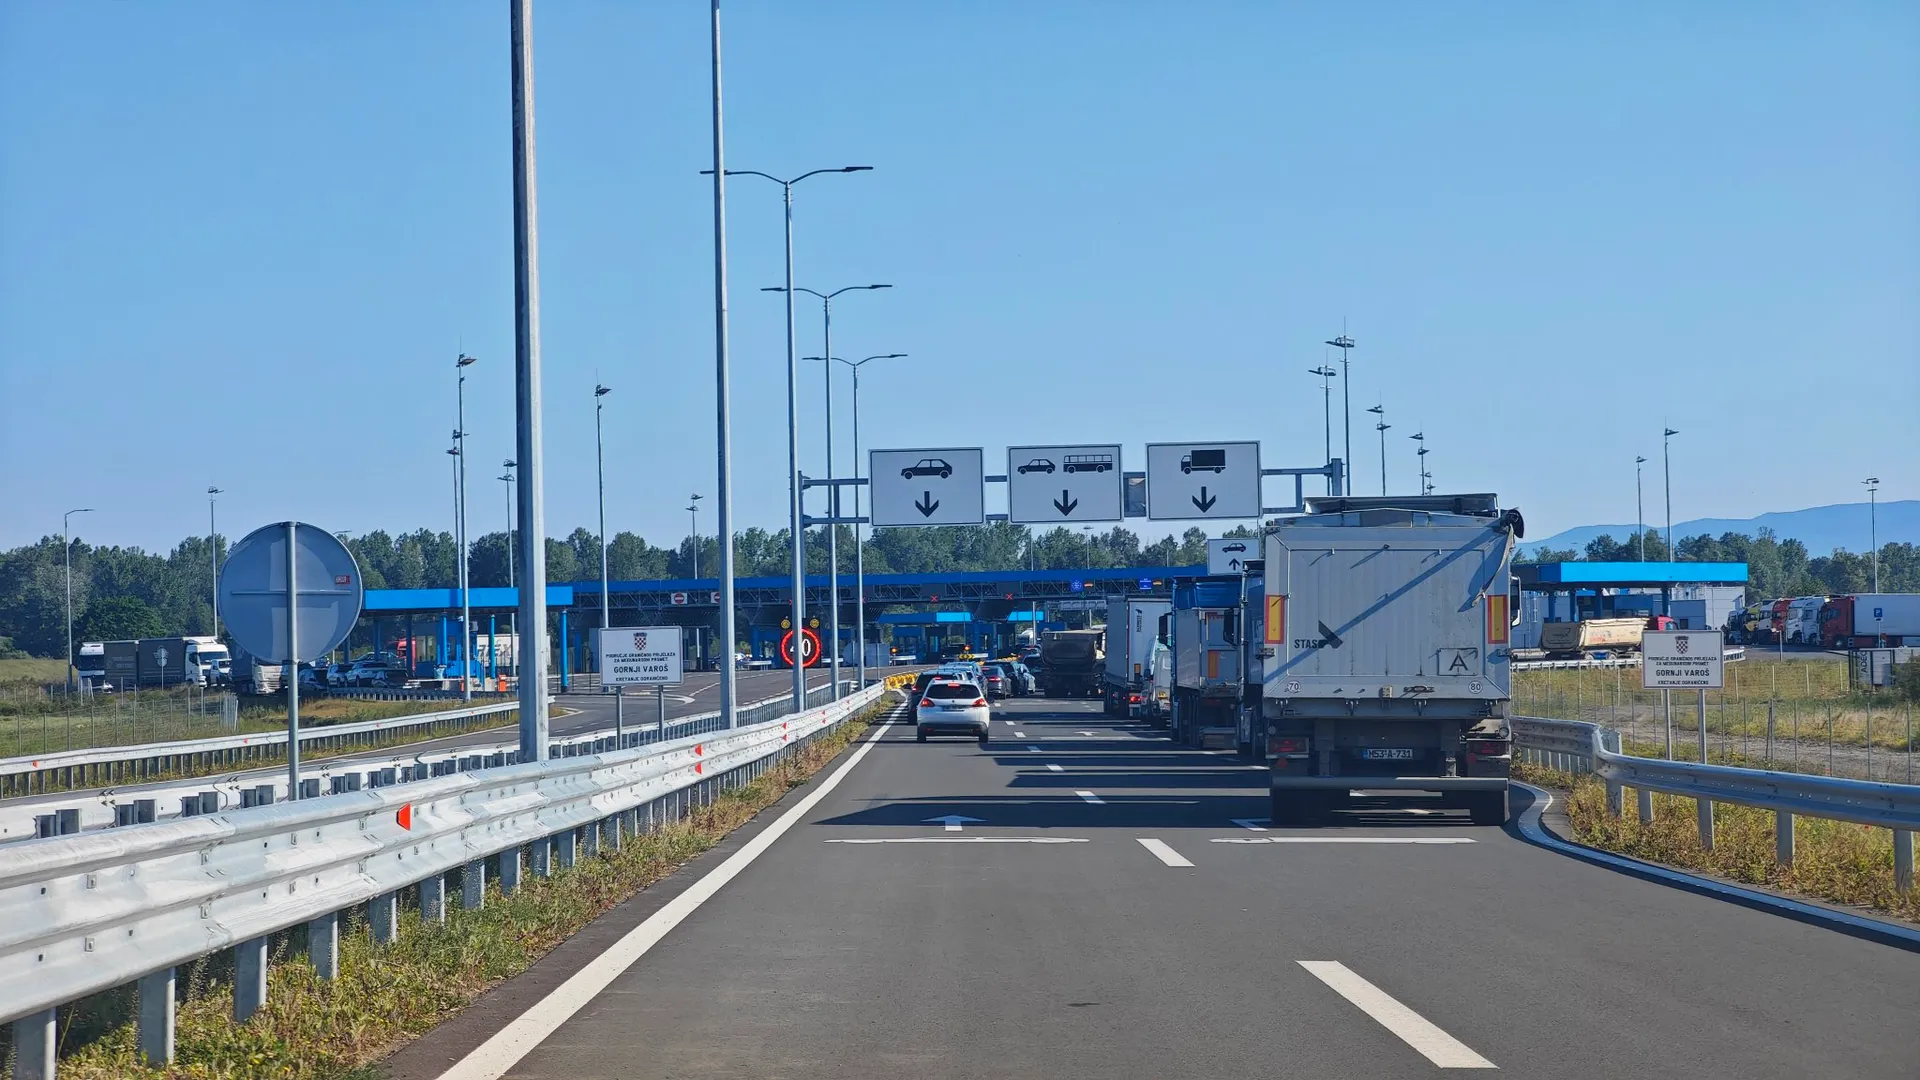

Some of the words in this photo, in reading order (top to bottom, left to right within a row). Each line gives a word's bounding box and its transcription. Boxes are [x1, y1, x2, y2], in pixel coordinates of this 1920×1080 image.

[1294, 639, 1317, 649] STAS
[1448, 653, 1469, 671] A
[614, 666, 641, 674] GORNJI
[643, 664, 669, 673] VAROŠ
[1656, 669, 1682, 677] GORNJI
[1684, 668, 1710, 677] VAROŠ
[1288, 682, 1299, 691] 70
[1470, 683, 1481, 691] 80
